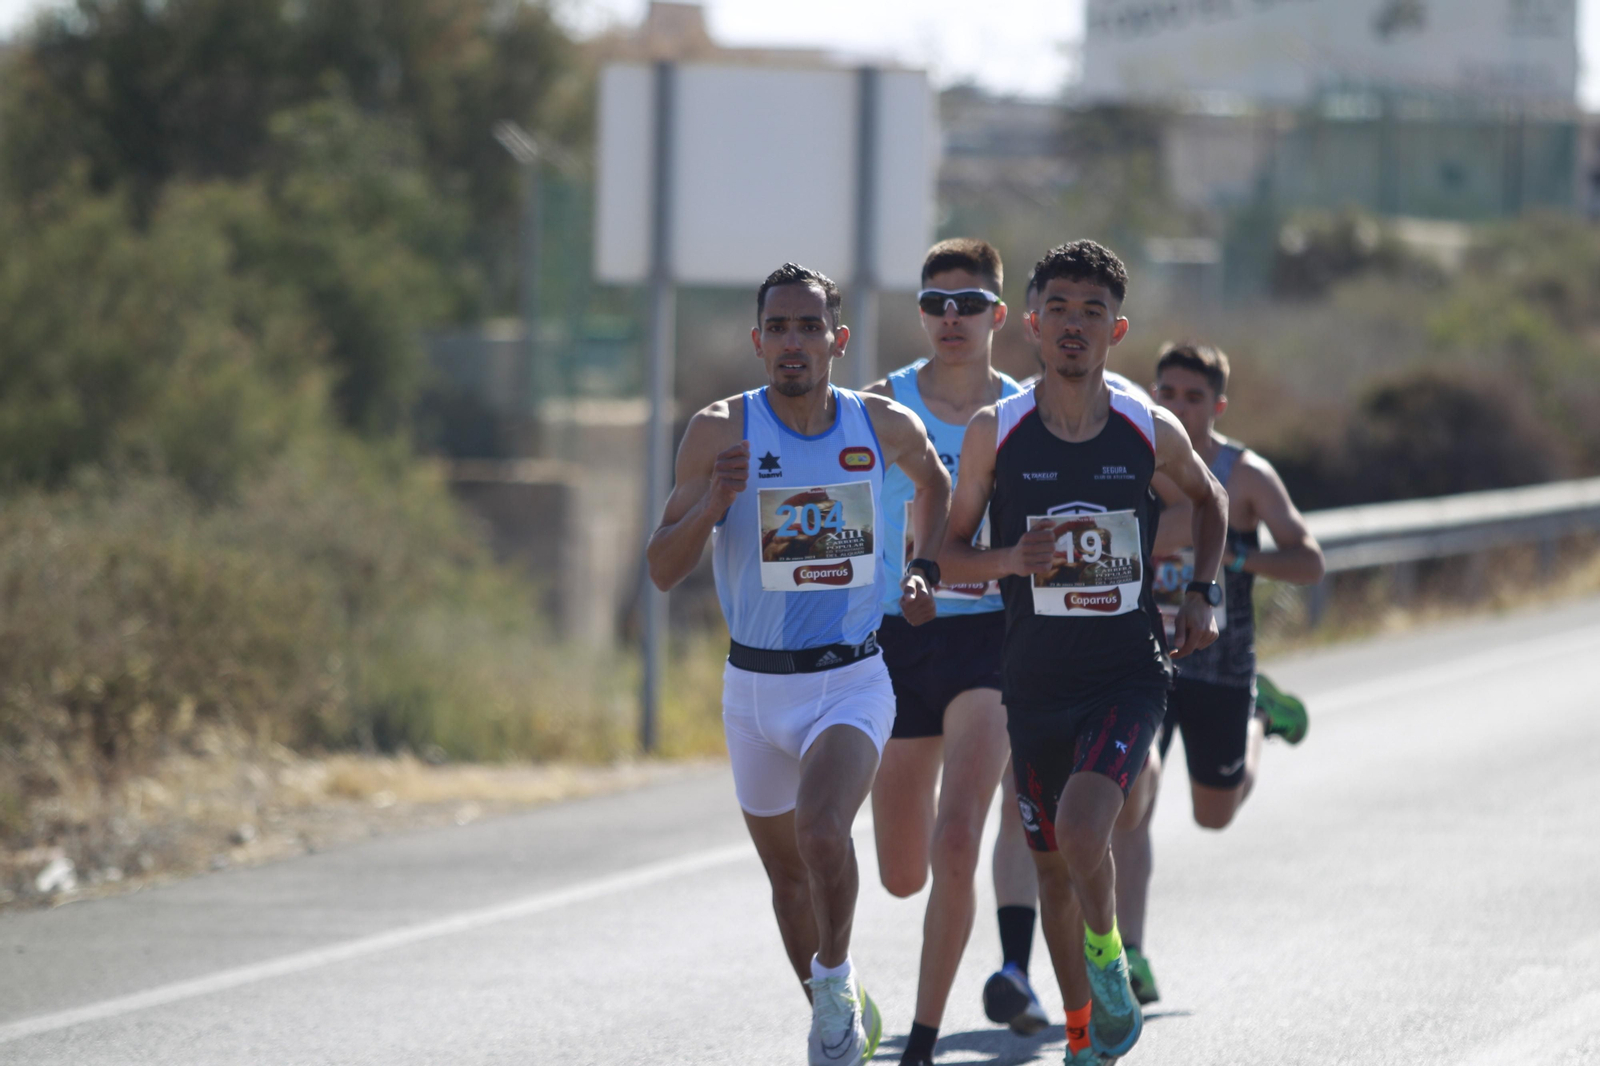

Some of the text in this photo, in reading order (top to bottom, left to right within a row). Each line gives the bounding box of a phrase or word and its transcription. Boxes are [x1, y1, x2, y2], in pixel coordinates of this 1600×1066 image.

[758, 471, 783, 479] luanvi
[1102, 466, 1128, 475] SEGURA
[775, 500, 846, 537] 204
[826, 530, 864, 541] XIII
[1056, 531, 1102, 564] 19
[1095, 558, 1132, 569] XIII
